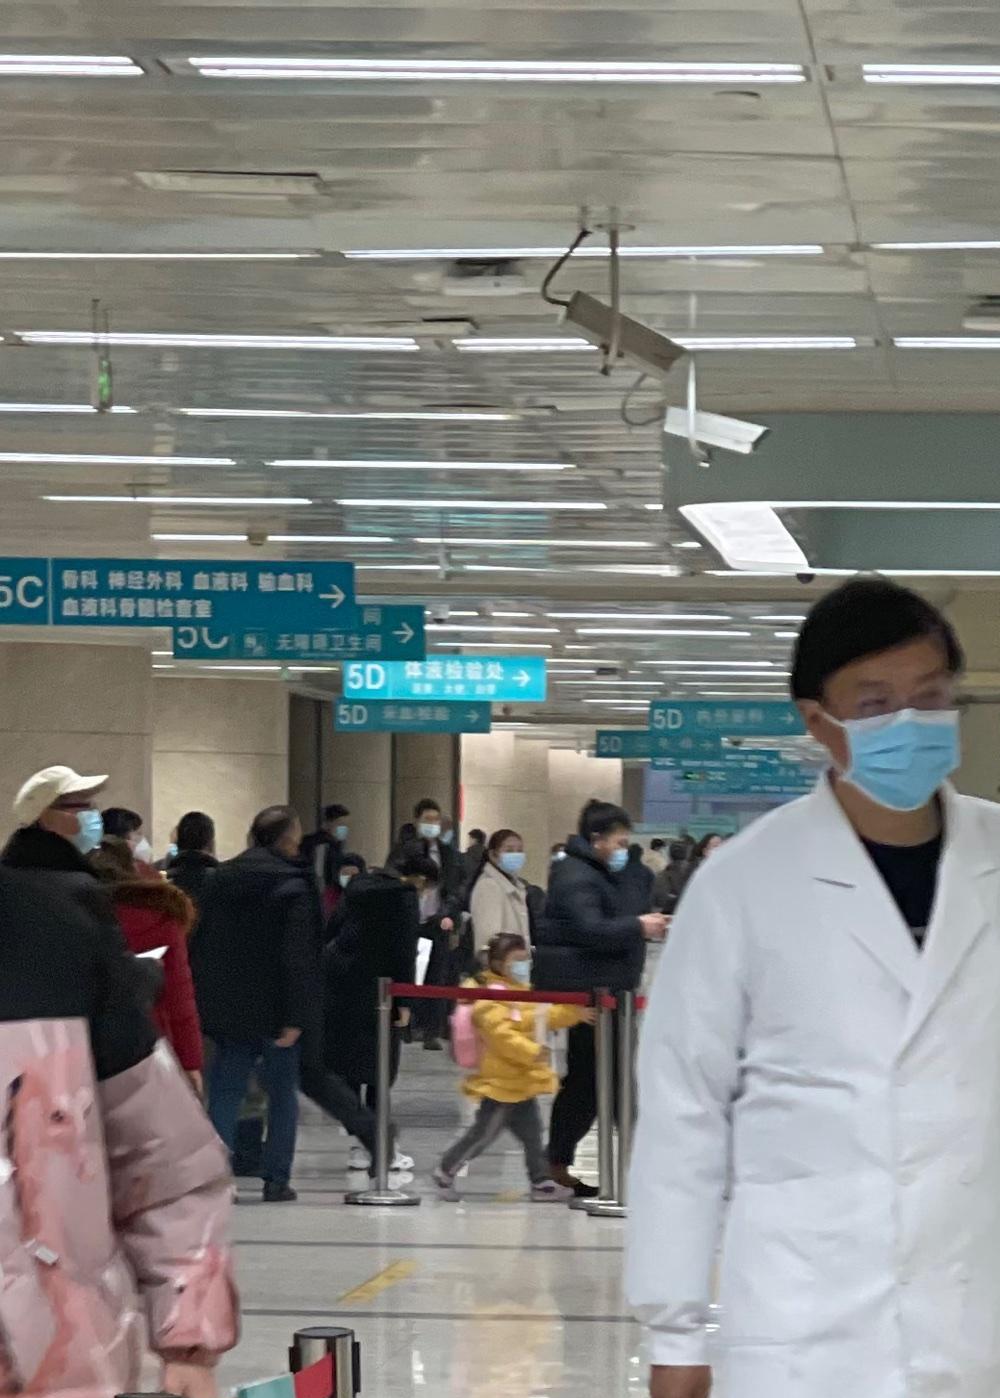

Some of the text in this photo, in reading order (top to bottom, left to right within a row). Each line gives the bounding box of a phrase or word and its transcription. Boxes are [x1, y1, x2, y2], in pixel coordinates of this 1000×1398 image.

[63, 570, 98, 590] 骨科
[109, 570, 183, 590] 神经外科
[193, 572, 247, 592] 血液科
[348, 663, 385, 690] 5D
[338, 704, 368, 725] 5D
[653, 709, 683, 730] 5D
